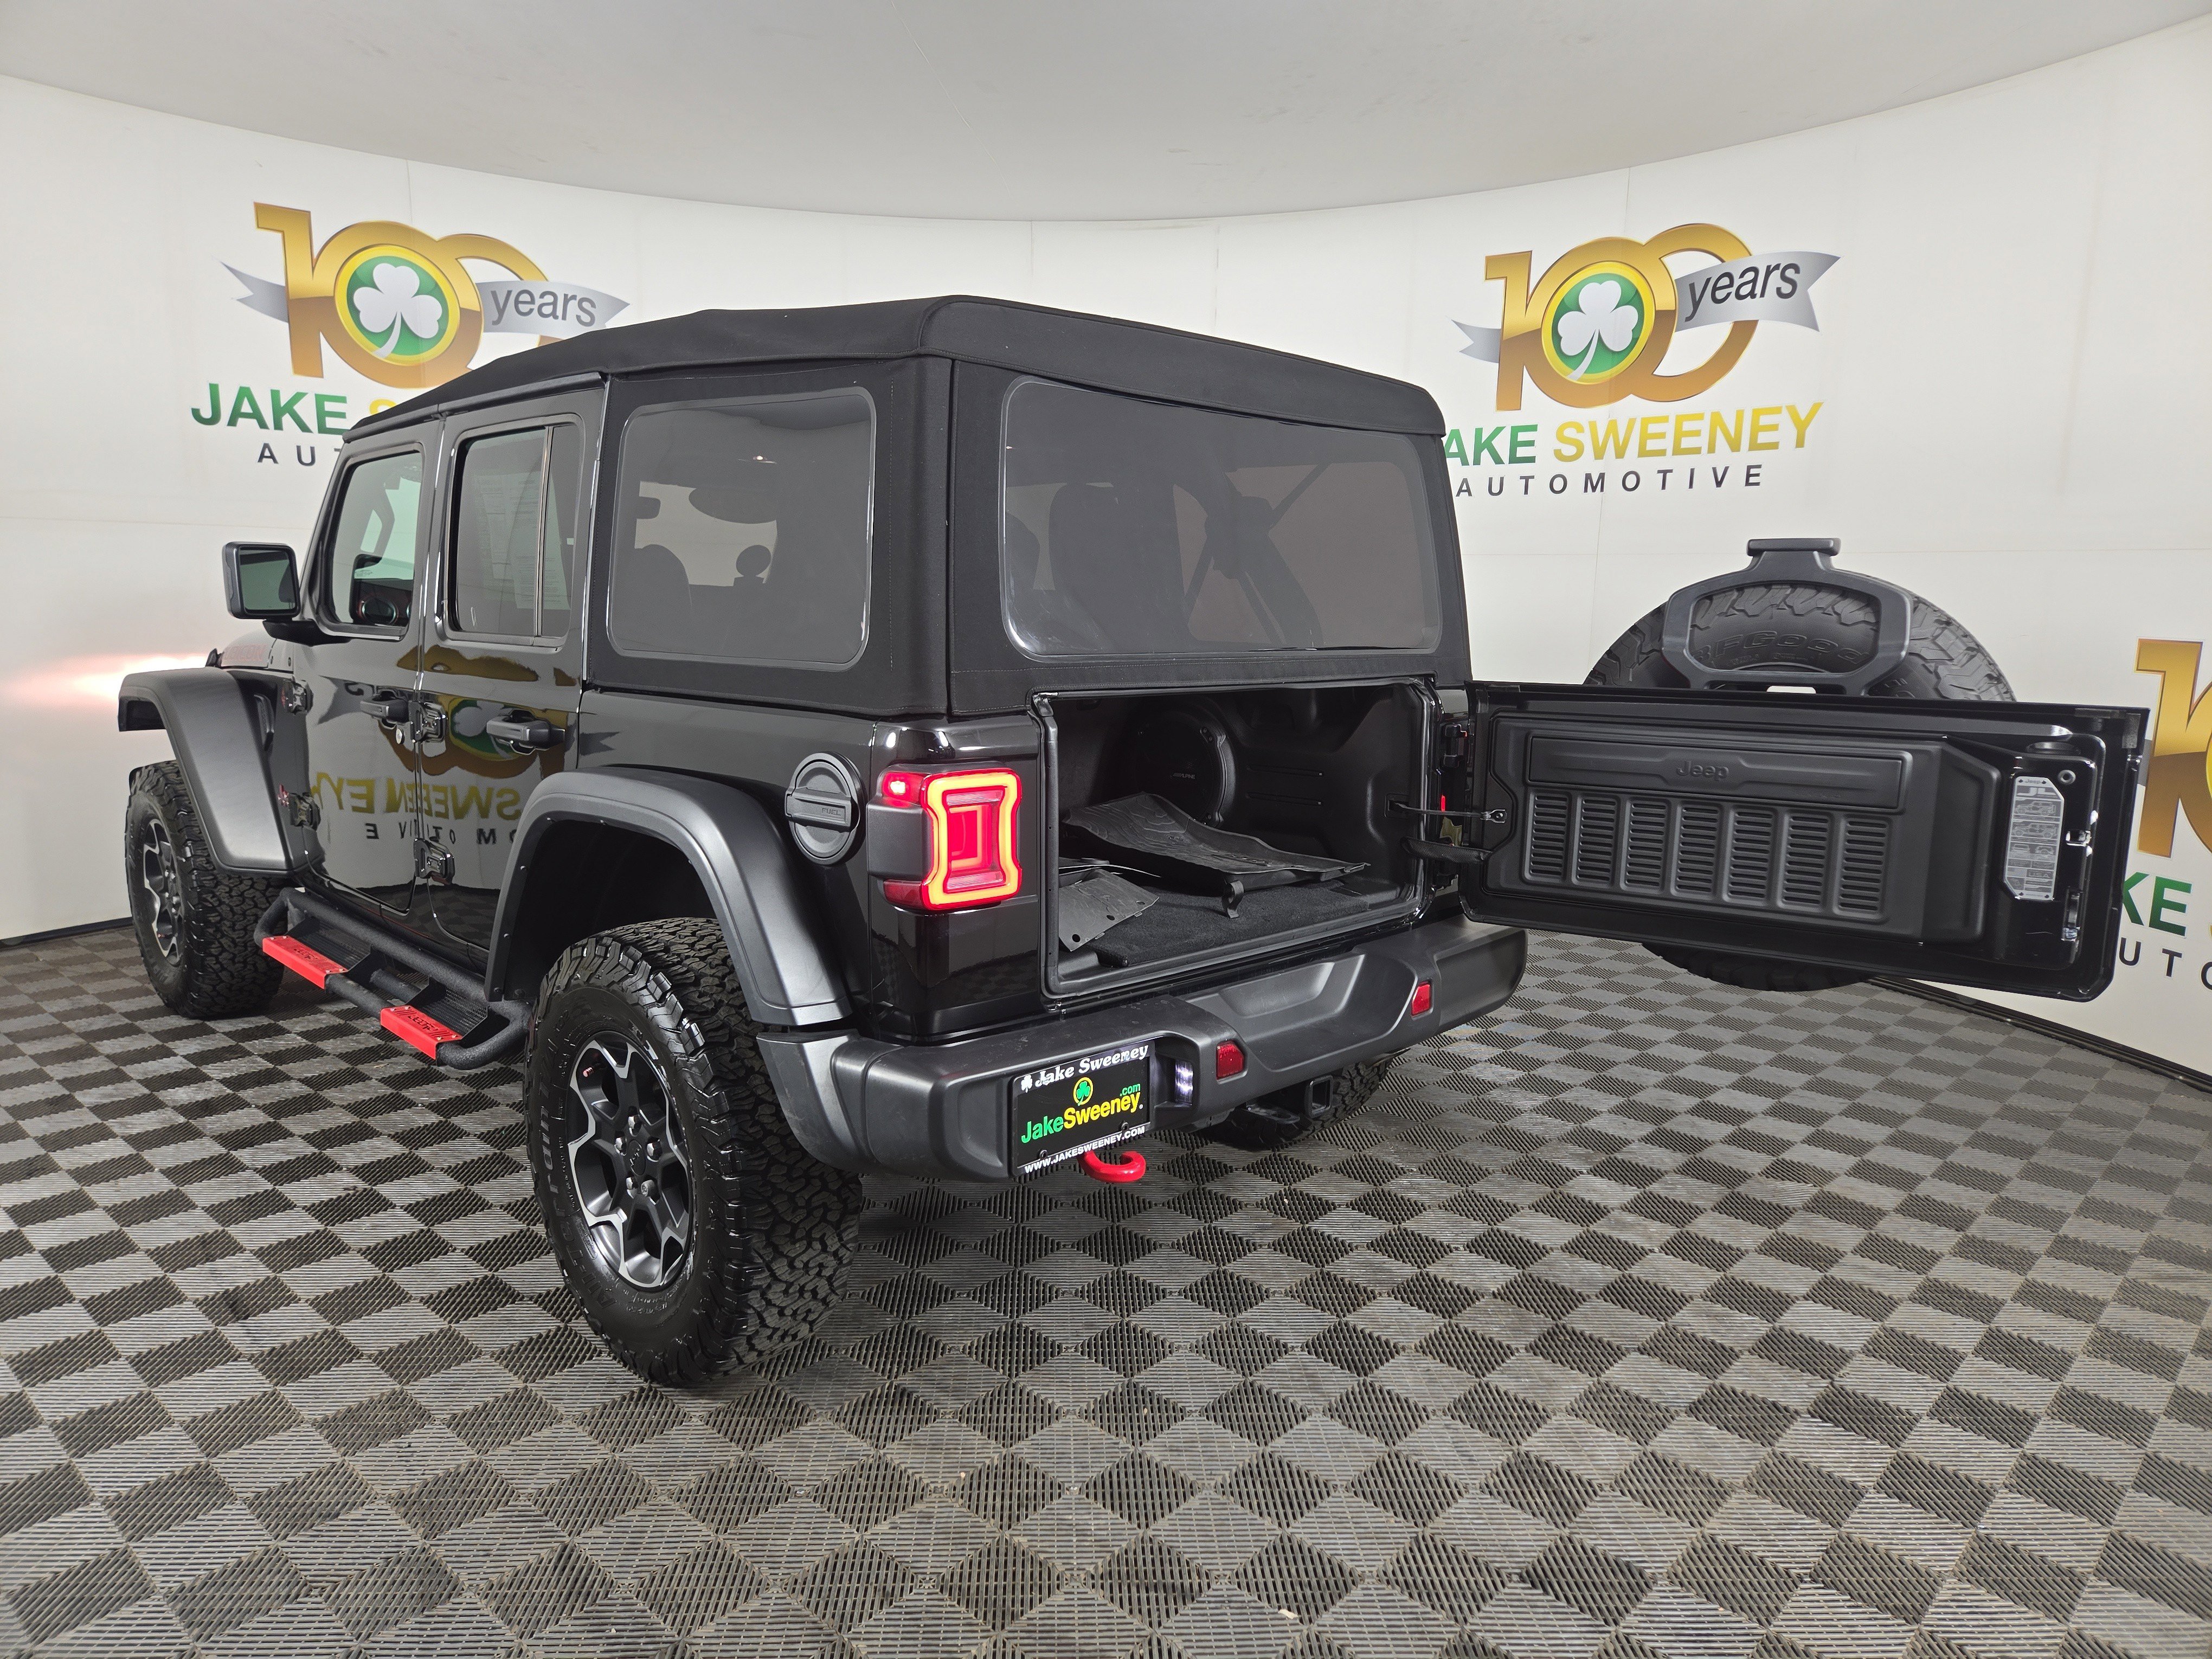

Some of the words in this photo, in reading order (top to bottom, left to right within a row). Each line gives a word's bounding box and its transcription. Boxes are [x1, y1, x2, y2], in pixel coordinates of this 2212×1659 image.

[491, 289, 597, 328] years
[1484, 223, 1760, 413] 100
[1684, 262, 1801, 323] years
[191, 382, 349, 435] JAKE
[1444, 423, 1539, 467] AKE
[1553, 401, 1825, 464] SWEENEY
[1455, 464, 1763, 498] AUTOMOTIVE
[1676, 760, 1729, 782] Jeep
[821, 808, 841, 816] FUEL
[1035, 1065, 1075, 1088] Jake
[1078, 1045, 1149, 1074] Sweeney
[1024, 1126, 1146, 1173] WWW.JAKESWEENEY.COM
